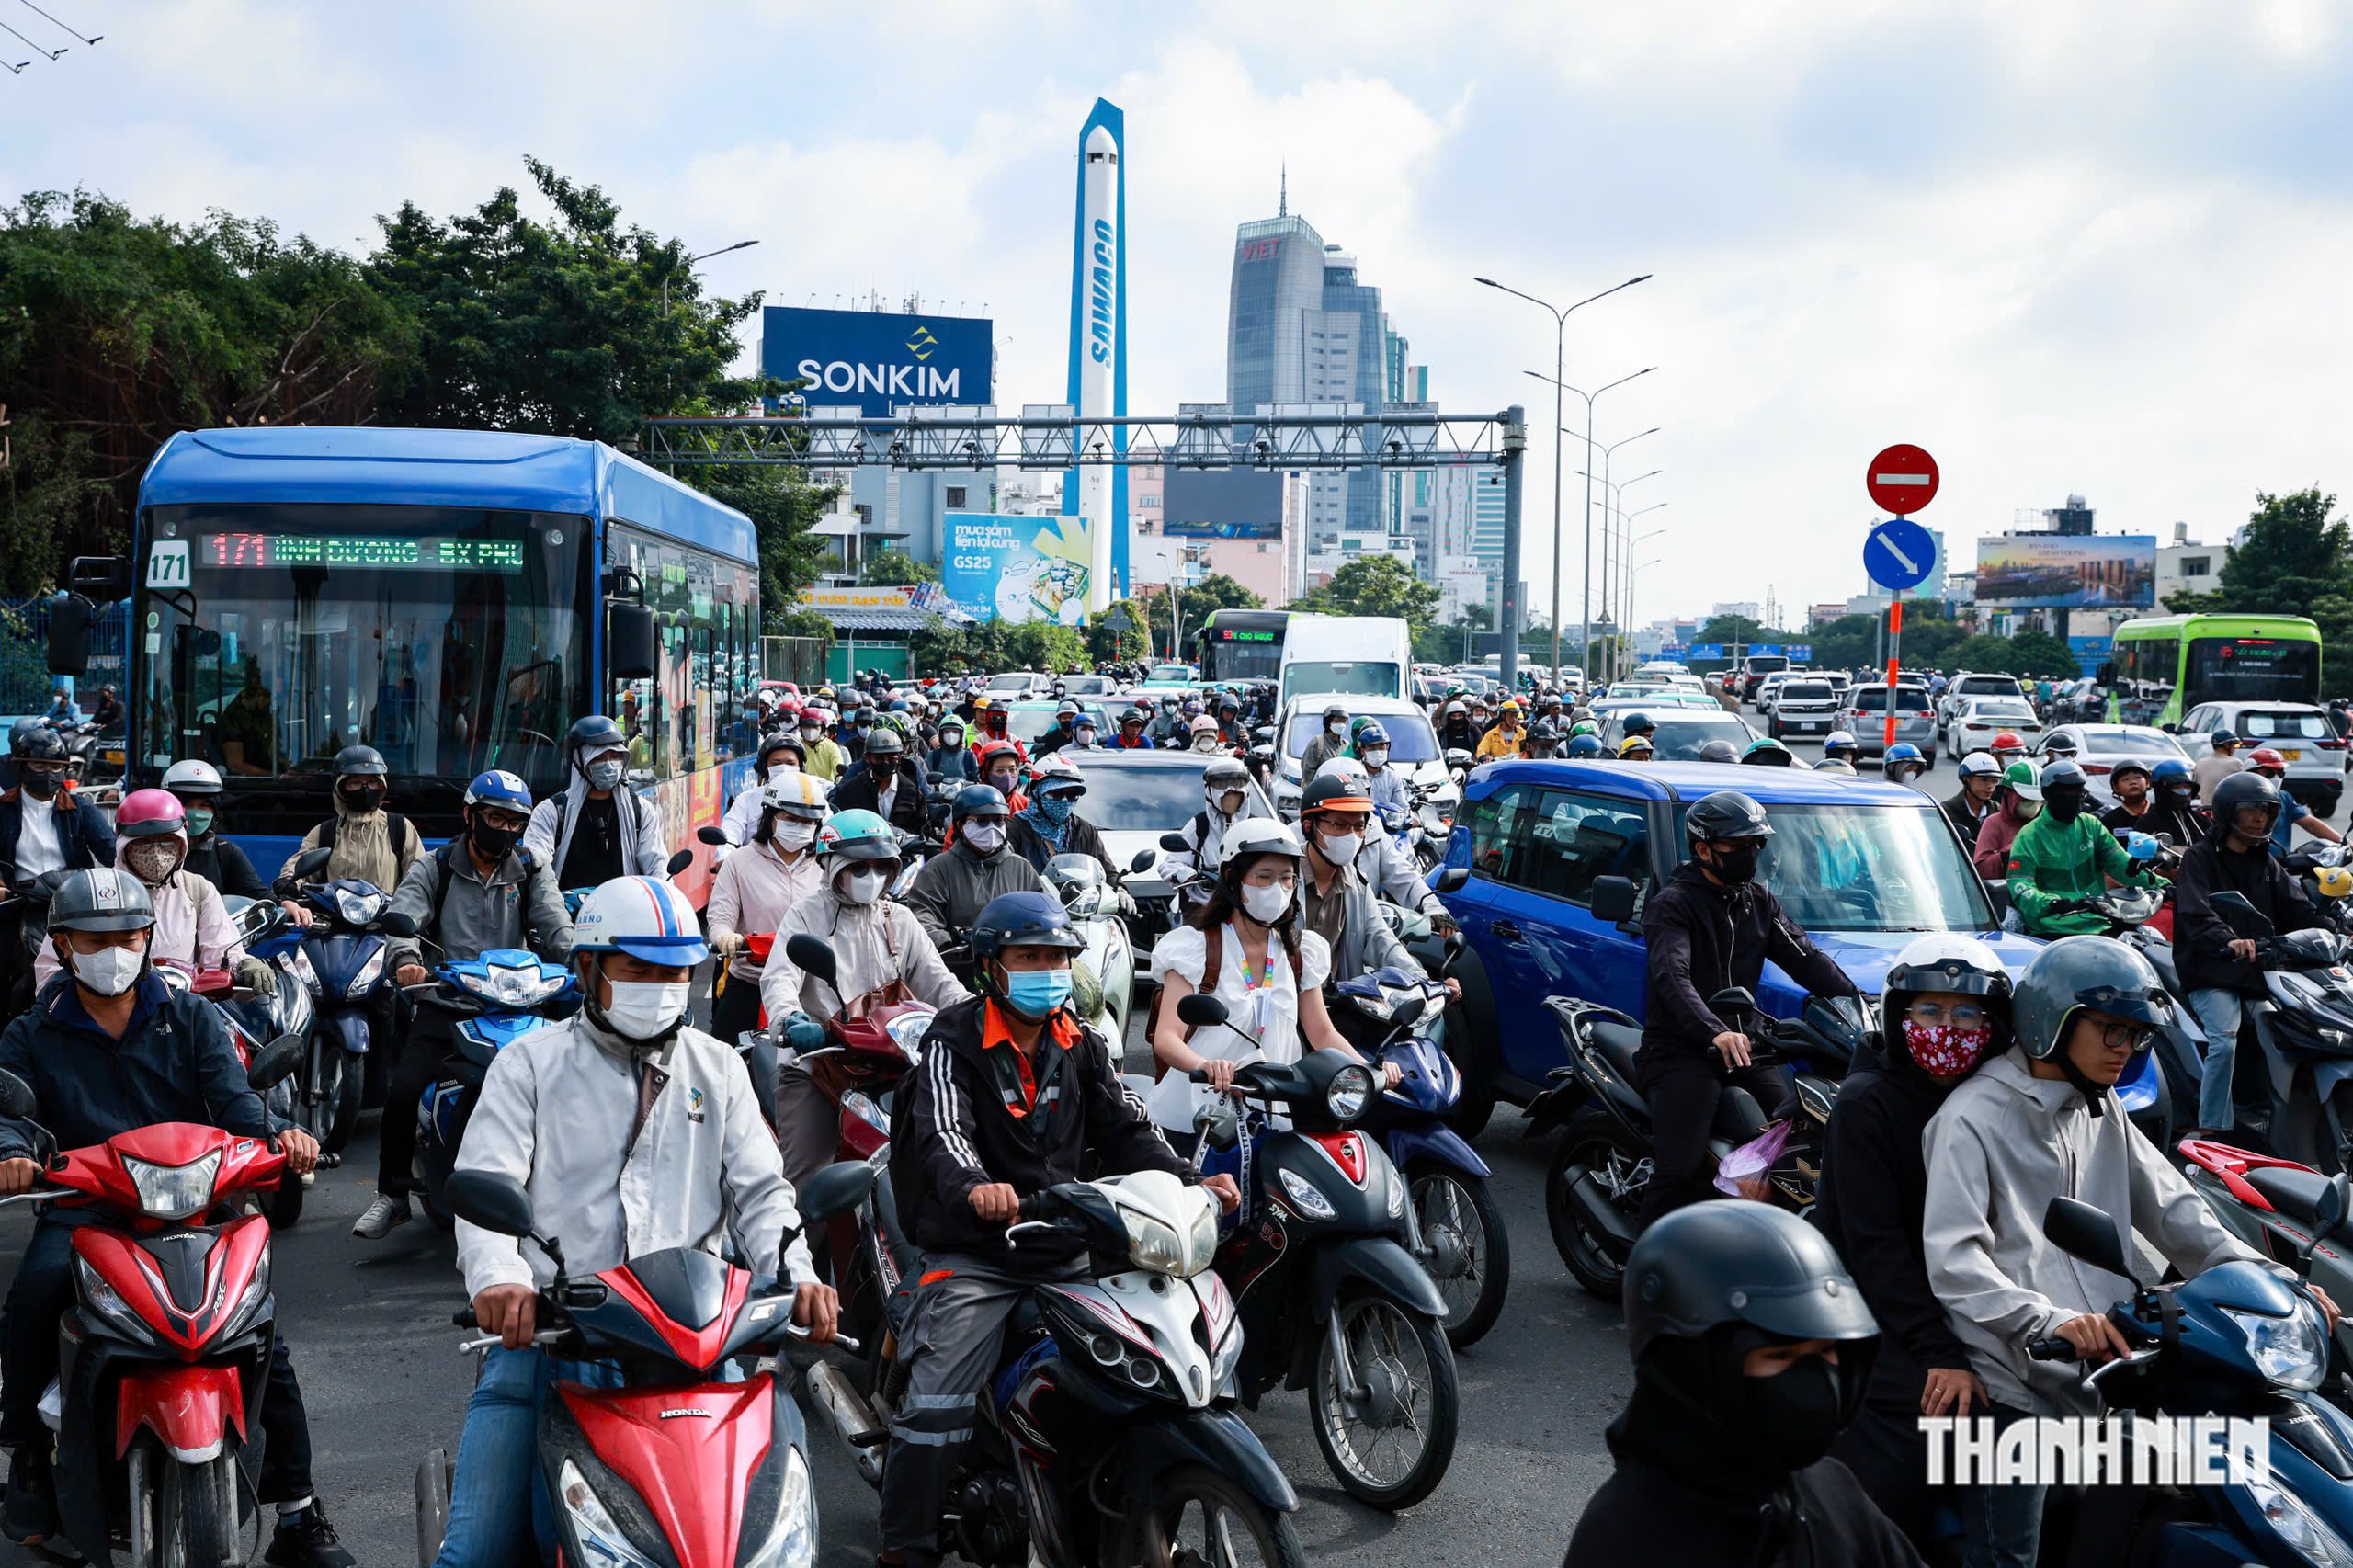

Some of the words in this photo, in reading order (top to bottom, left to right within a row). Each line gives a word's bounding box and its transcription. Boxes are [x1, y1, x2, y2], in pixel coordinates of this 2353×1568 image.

[1091, 218, 1115, 369] SAWACO
[797, 358, 960, 398] SONKIM
[955, 525, 984, 535] mua
[985, 520, 1011, 536] sắm
[213, 533, 264, 566] 171
[440, 543, 472, 564] BX
[151, 554, 186, 581] 171
[954, 555, 992, 569] GS25
[958, 604, 991, 613] ONKIM
[1239, 1124, 1250, 1163] BETTER
[1268, 1202, 1288, 1222] SYM
[660, 1408, 711, 1419] HONDA
